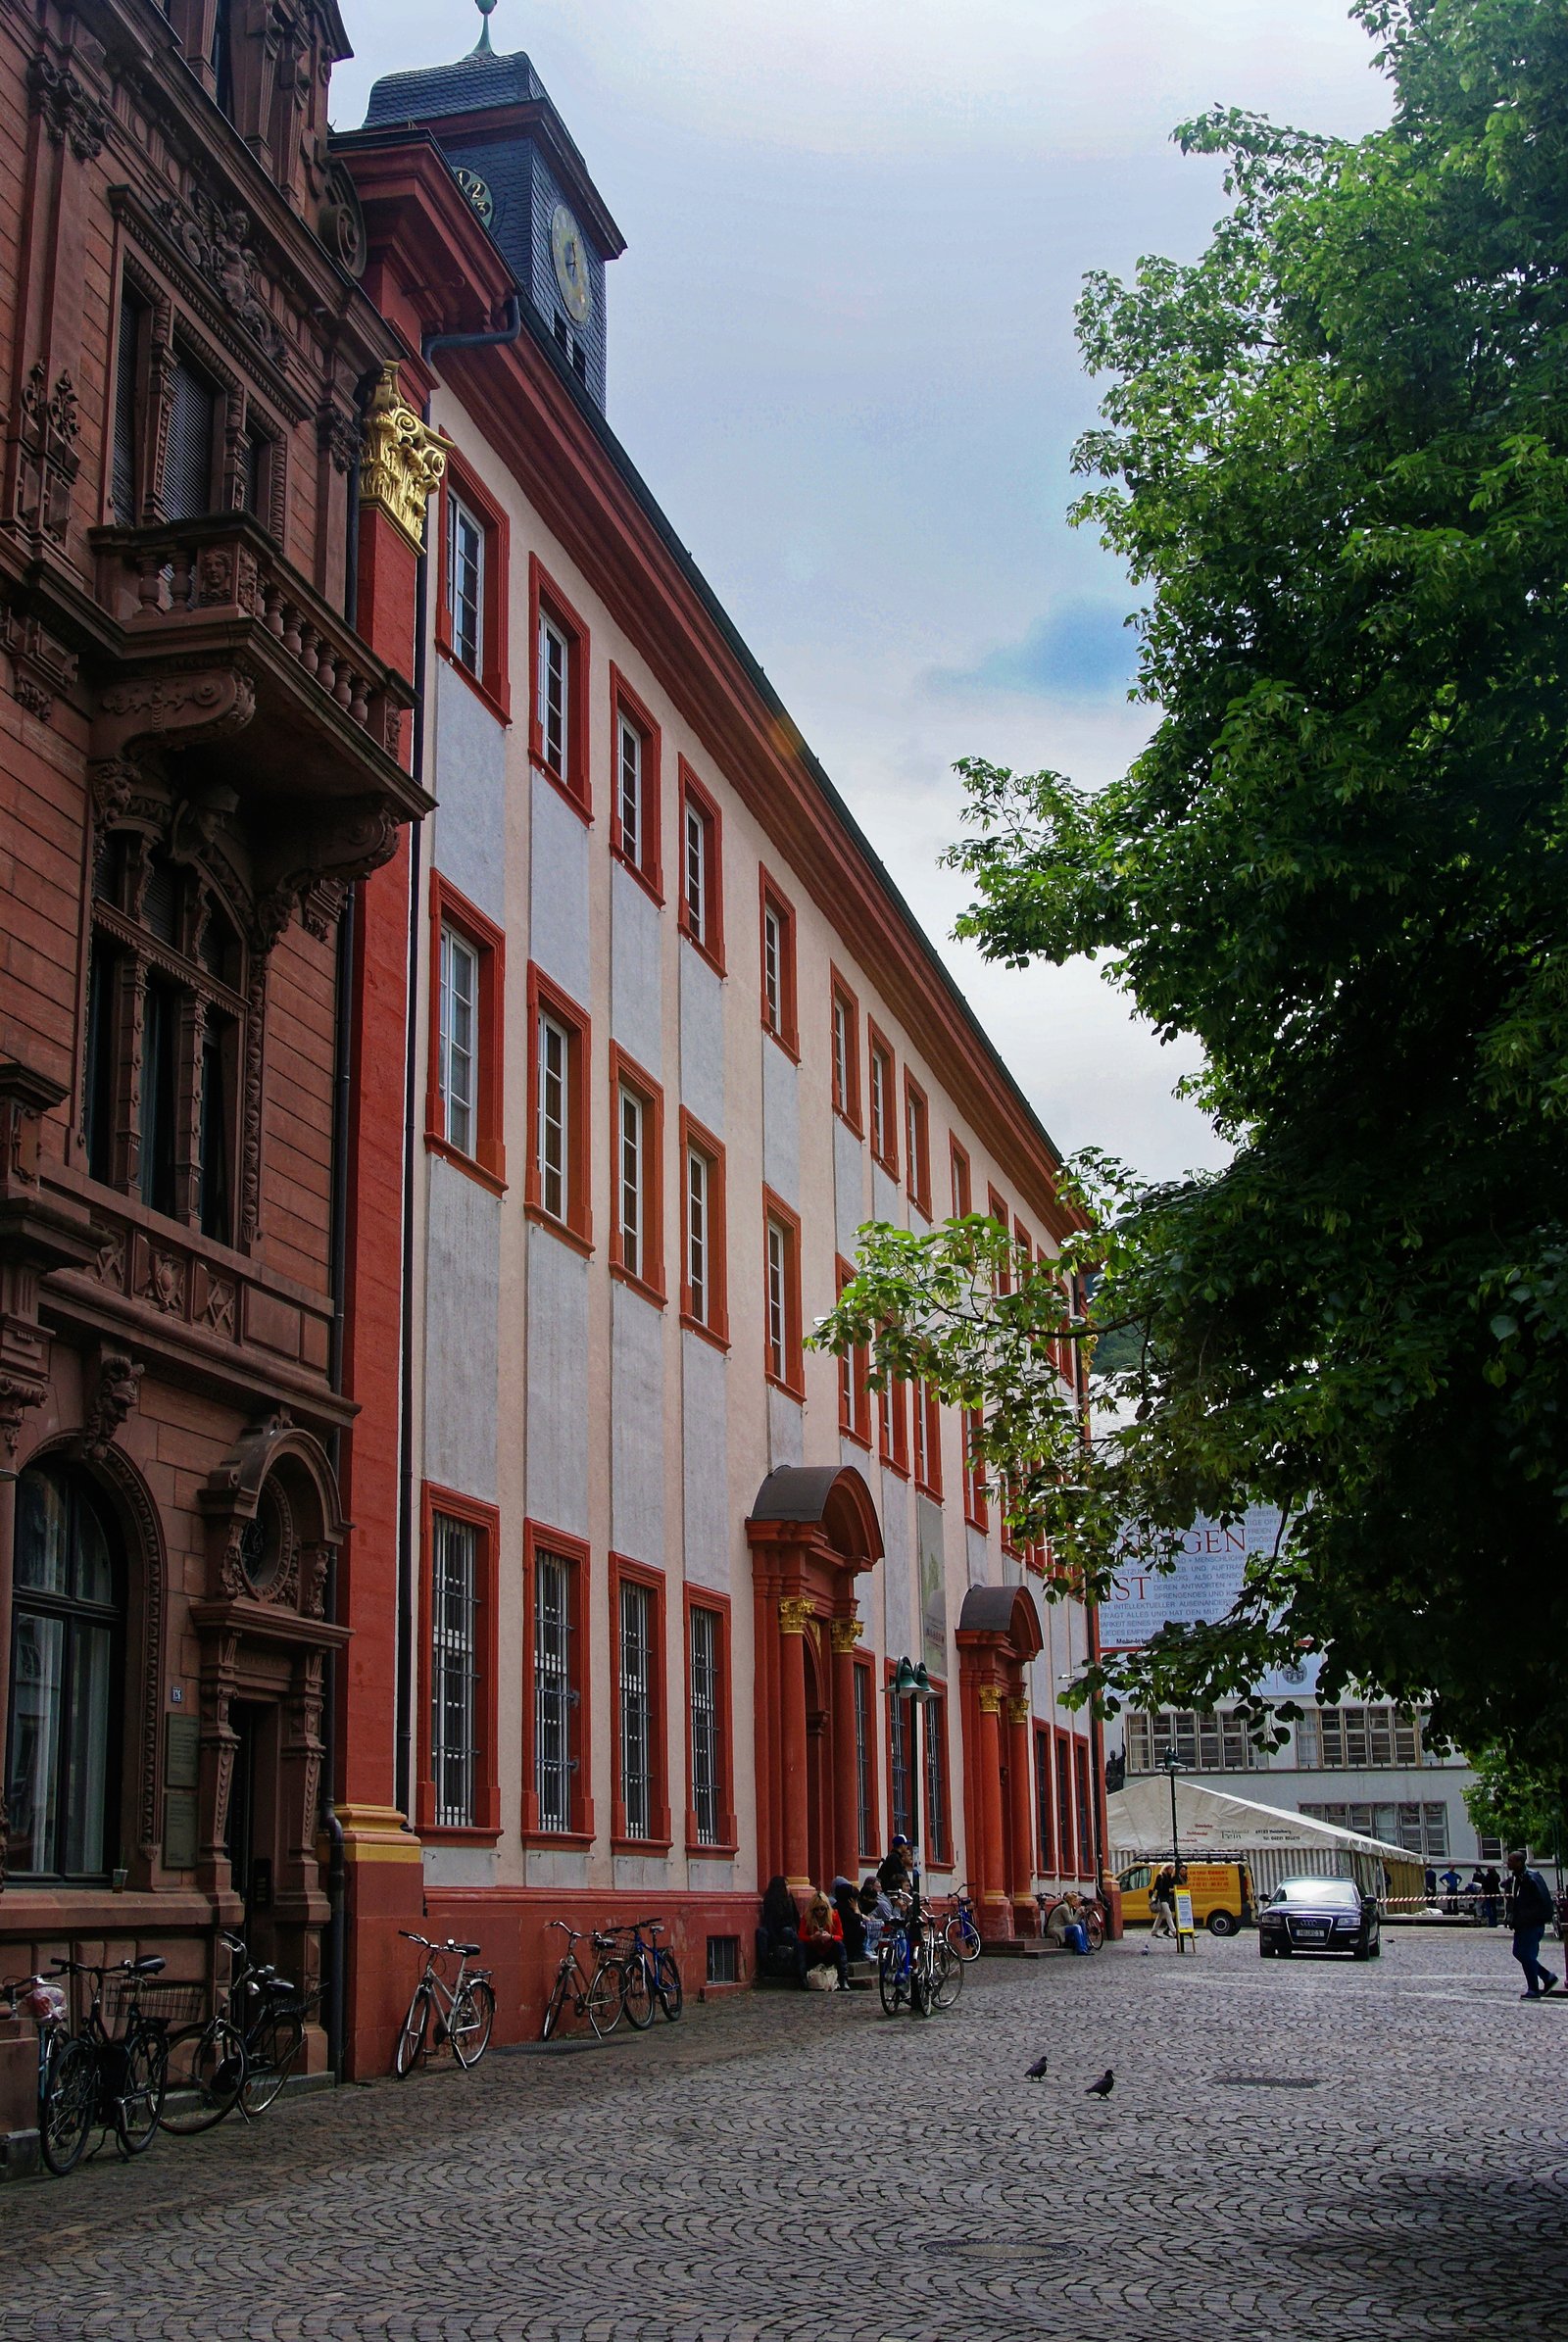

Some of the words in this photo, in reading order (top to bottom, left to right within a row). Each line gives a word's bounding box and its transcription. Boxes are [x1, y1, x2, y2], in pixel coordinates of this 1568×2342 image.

[471, 183, 481, 199] 2
[477, 202, 486, 217] 3
[1181, 1582, 1226, 1590] ANTWORTEN
[1153, 1591, 1207, 1600] SPRENGENDES
[1113, 1600, 1176, 1611] INTELLEKTUELLER
[1179, 1597, 1238, 1608] AUSEINANDERSE
[1100, 1611, 1124, 1620] FRAGT
[1126, 1610, 1150, 1619] ALLES
[1151, 1609, 1167, 1618] UND
[1185, 1607, 1201, 1616] DEN
[1126, 1619, 1150, 1628] SEINES
